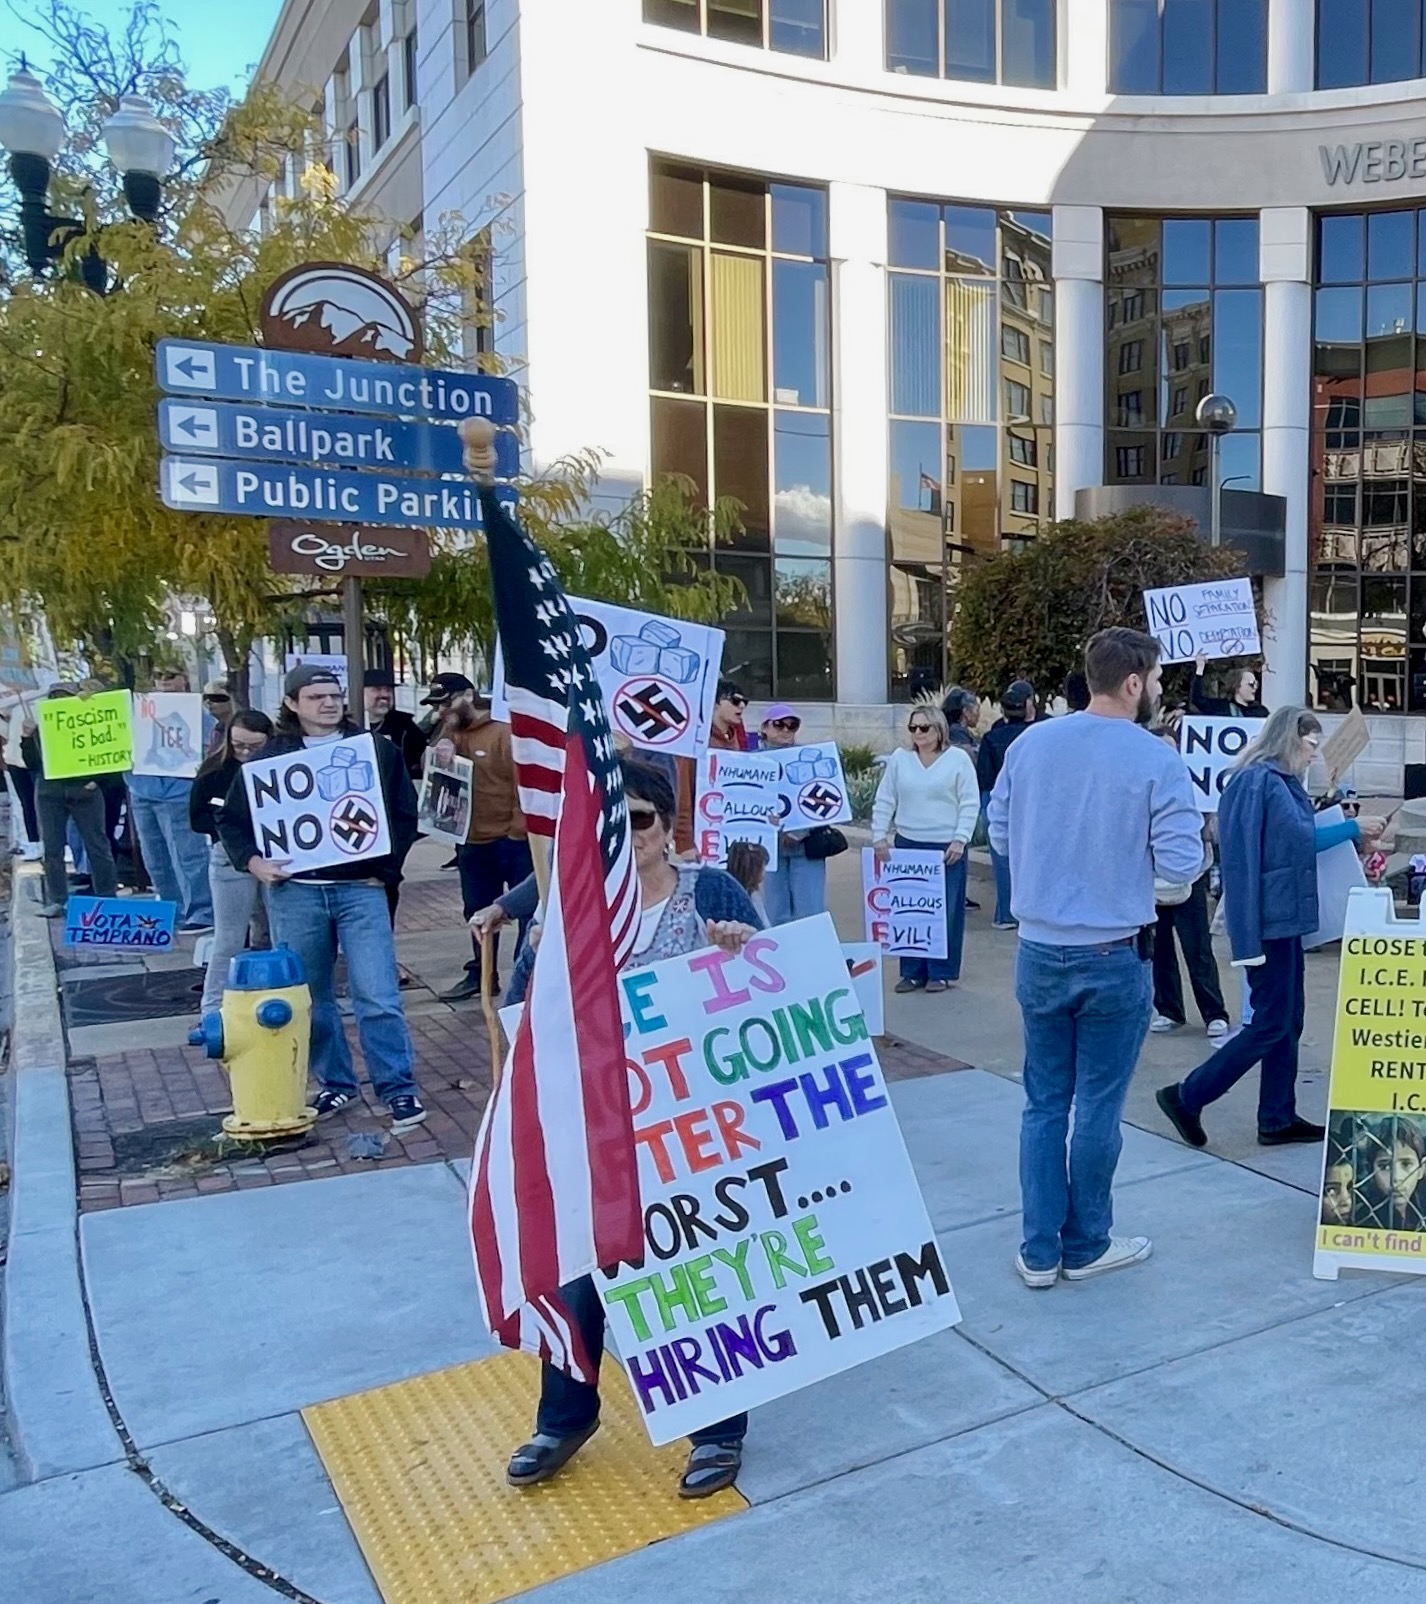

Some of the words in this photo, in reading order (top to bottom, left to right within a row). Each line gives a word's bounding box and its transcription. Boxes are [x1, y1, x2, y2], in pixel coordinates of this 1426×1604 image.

[233, 356, 307, 398] The
[324, 368, 493, 416] Junction
[235, 416, 395, 461] Ballpark
[235, 471, 360, 513] Public
[291, 531, 408, 571] Ogden
[1150, 592, 1187, 628] NO
[1157, 629, 1194, 662] NO
[72, 733, 85, 749] is
[1186, 725, 1247, 756] NO
[252, 763, 314, 808] NO
[261, 814, 323, 858] NO
[66, 927, 171, 946] TEMPRANO
[1347, 938, 1416, 957] CLOSE
[688, 937, 787, 1015] IS
[1359, 967, 1415, 987] I.C.E.
[1345, 997, 1405, 1018] CELL!
[626, 1037, 693, 1116] OT
[703, 987, 868, 1086] GOING
[634, 1100, 761, 1185] TER
[750, 1053, 887, 1140] THE
[1332, 1230, 1379, 1250] can't
[1384, 1232, 1422, 1253] find
[604, 1214, 834, 1342] THEY'RE
[626, 1304, 798, 1413] HIRING
[800, 1241, 951, 1340] THEM
